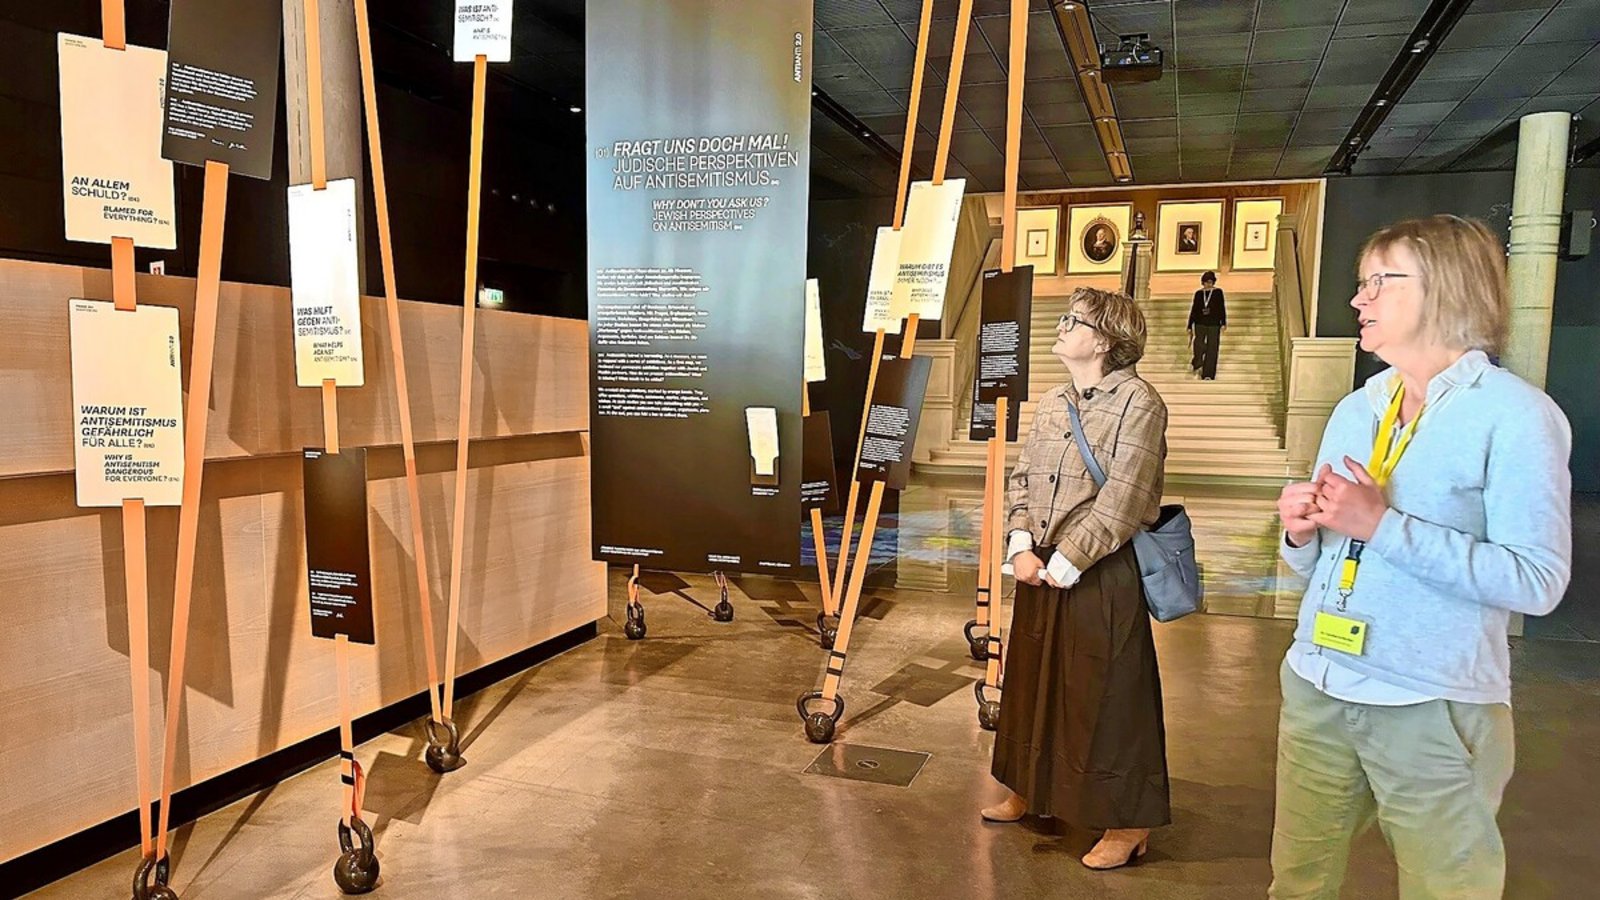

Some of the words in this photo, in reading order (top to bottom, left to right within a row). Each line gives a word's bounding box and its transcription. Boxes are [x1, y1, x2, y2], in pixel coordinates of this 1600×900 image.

[614, 140, 660, 156] FRAGT
[664, 138, 695, 154] UNS
[699, 136, 744, 152] DOCH
[748, 134, 788, 150] MAL!
[613, 156, 685, 173] JÜDISCHE
[690, 152, 798, 170] PERSPEKTIVEN
[71, 176, 88, 186] AN
[92, 178, 130, 190] ALLEM
[614, 174, 642, 190] AUF
[645, 170, 770, 188] ANTISEMITISMUS
[71, 186, 127, 200] SCHULD?
[652, 200, 676, 210] WHY
[676, 199, 705, 208] DON'T
[708, 198, 727, 208] YOU
[728, 198, 748, 208] ASK
[750, 197, 770, 207] US?
[104, 206, 136, 214] BLAMED
[652, 210, 687, 220] JEWISH
[690, 209, 755, 220] PERSPECTIVES
[652, 222, 666, 232] ON
[668, 220, 732, 231] ANTISEMITISM
[297, 307, 312, 316] WAS
[297, 316, 320, 326] GEGEN
[80, 405, 126, 416] WARUM
[129, 407, 147, 416] IST
[80, 416, 176, 427] ANTISEMITISMUS
[82, 426, 154, 437] GEFÄHRLICH
[82, 437, 105, 448] FÜR
[108, 439, 142, 448] ALLE?
